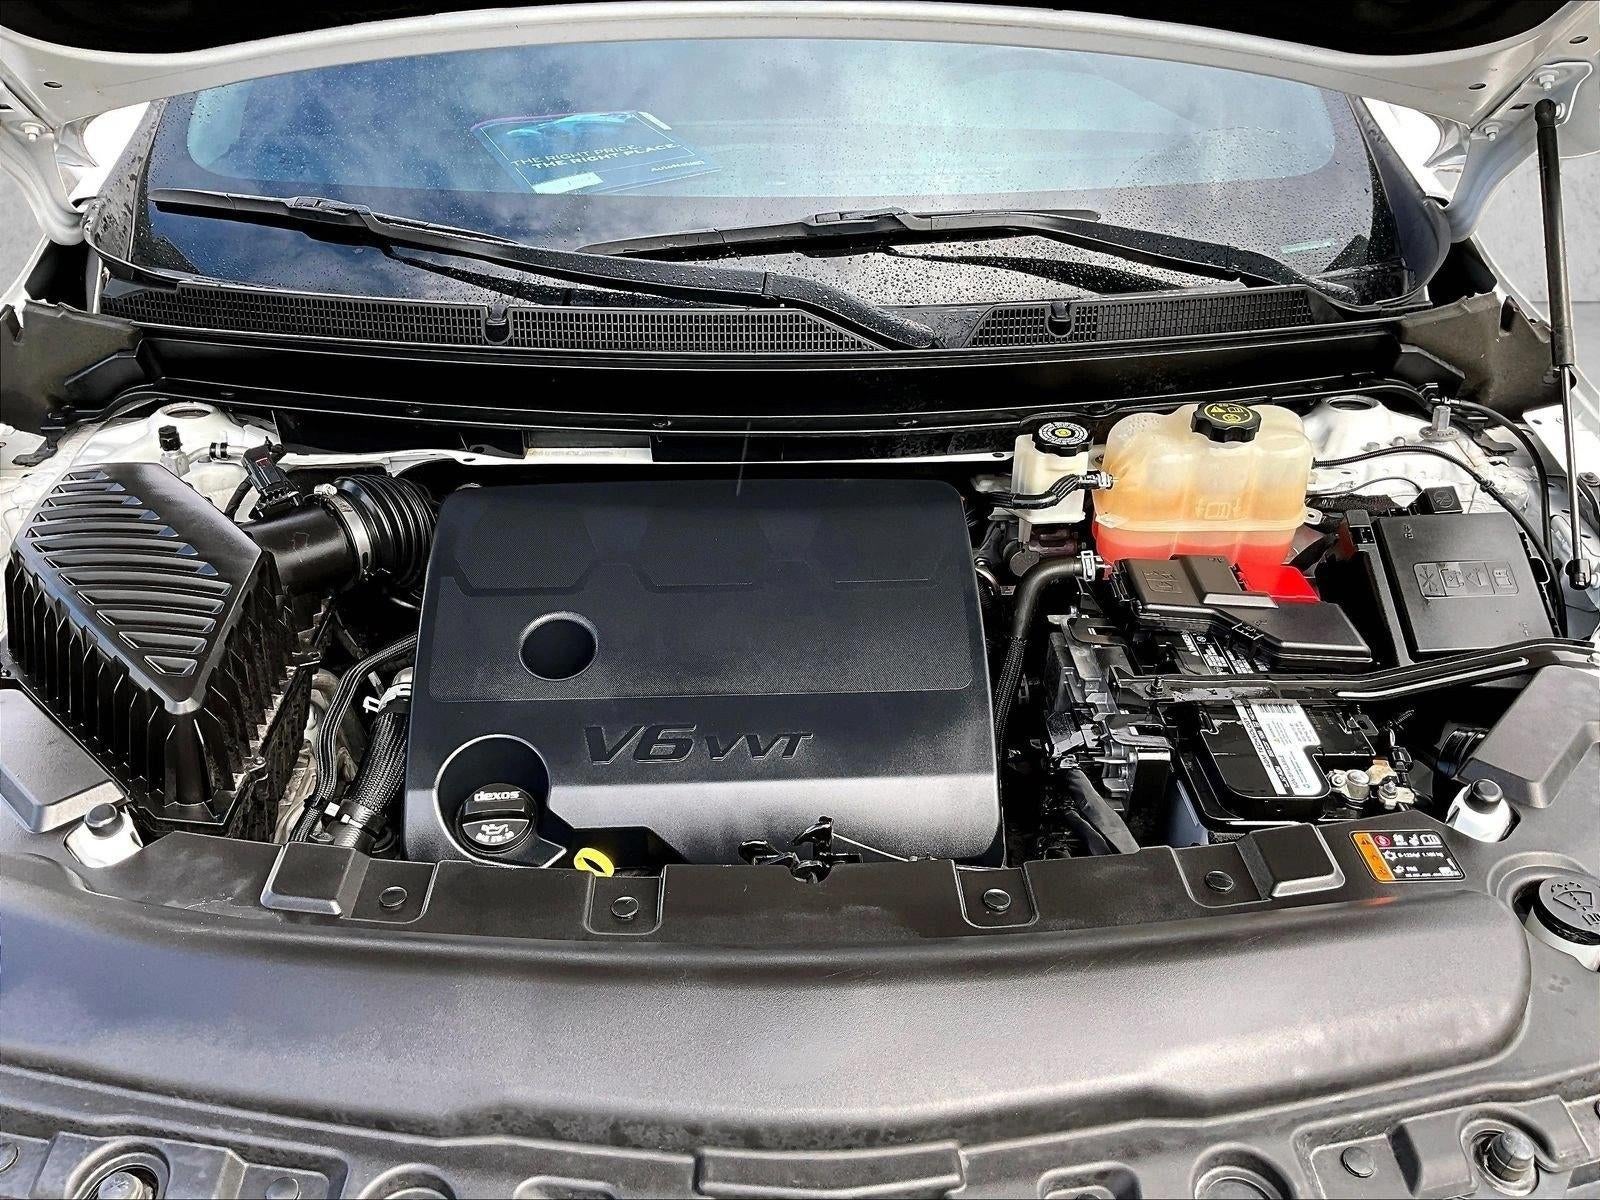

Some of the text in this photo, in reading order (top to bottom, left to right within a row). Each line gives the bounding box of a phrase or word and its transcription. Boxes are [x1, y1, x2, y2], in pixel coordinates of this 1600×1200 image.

[511, 144, 642, 167] THE RIGHT PRICE.
[532, 143, 681, 169] THE RIGHT PLACE.
[584, 723, 814, 765] V6 VVT
[473, 790, 520, 802] dexos
